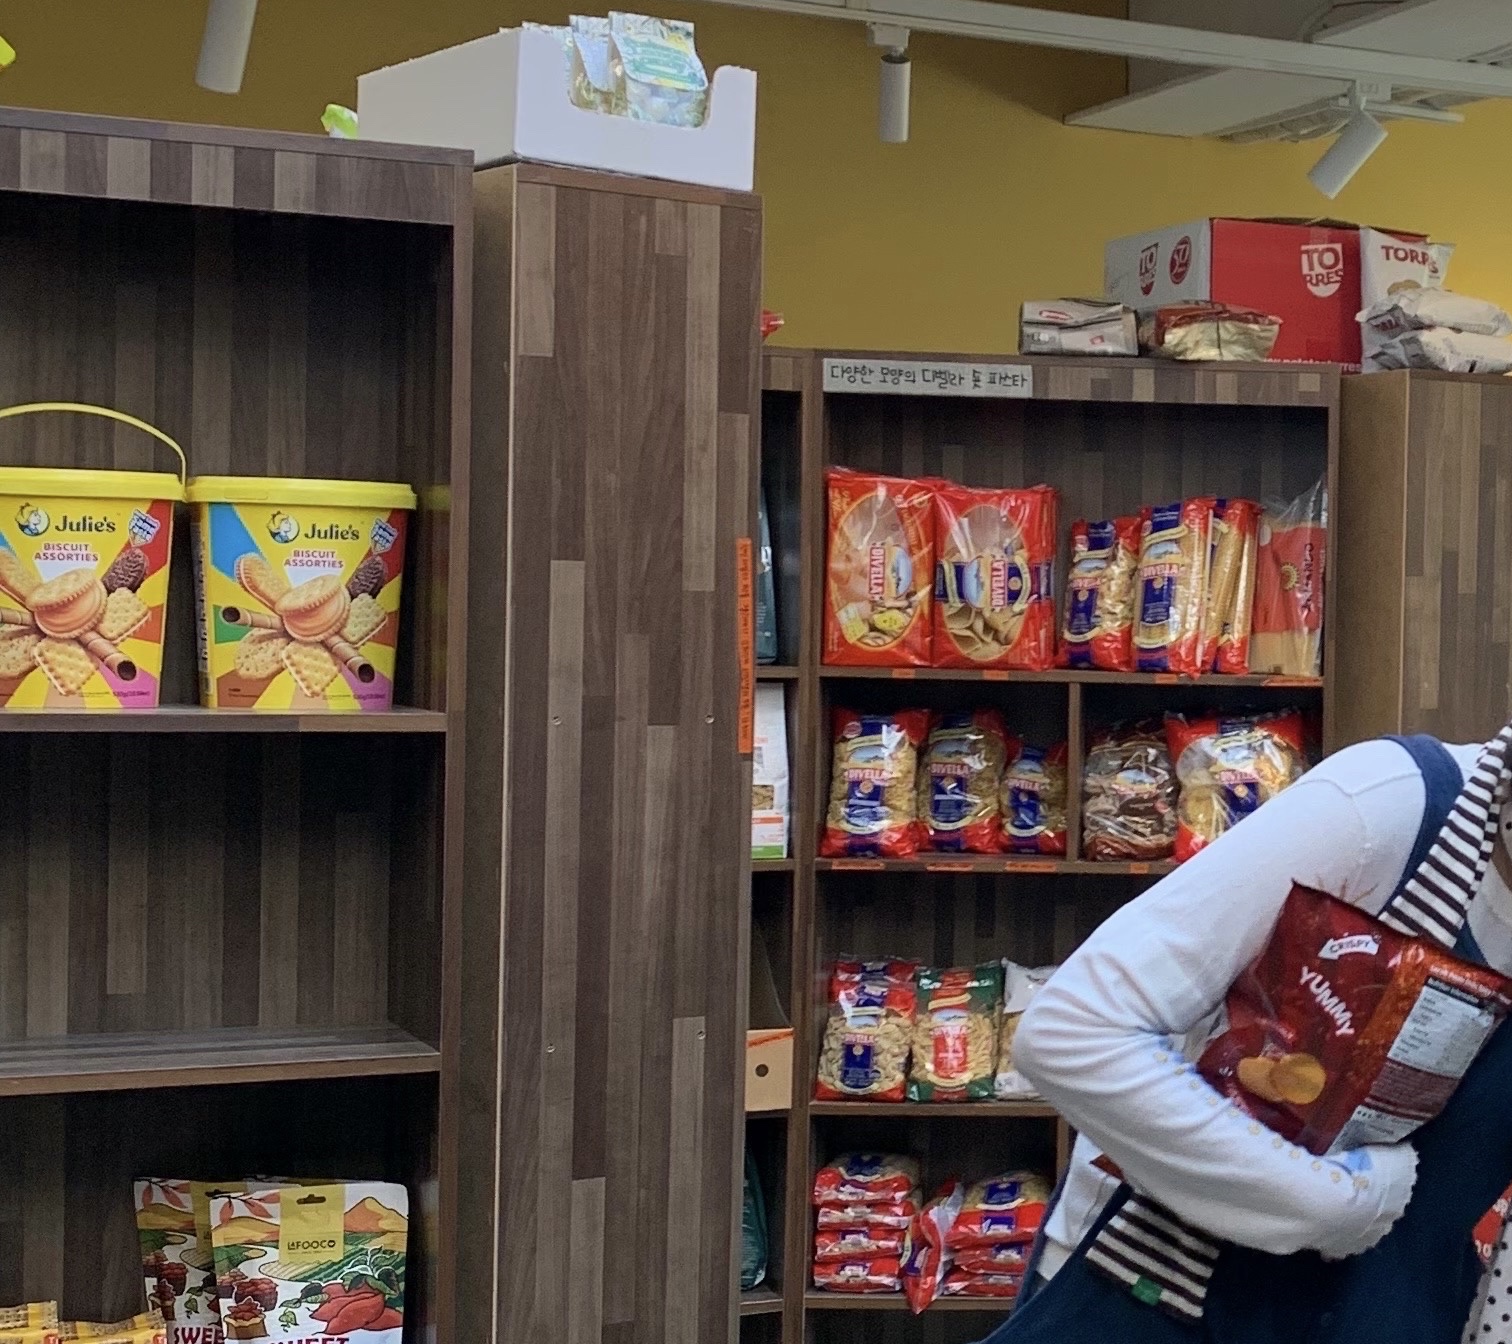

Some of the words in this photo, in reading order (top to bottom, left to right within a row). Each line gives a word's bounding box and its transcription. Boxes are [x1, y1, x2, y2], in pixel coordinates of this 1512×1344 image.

[1301, 244, 1342, 272] TO
[830, 364, 875, 385] 다양한
[879, 366, 917, 386] 모양의
[54, 513, 117, 534] Julie's
[303, 523, 361, 542] Julie's
[43, 542, 90, 553] BISCUIT
[292, 549, 337, 560] BISCUIT
[34, 551, 100, 563] ASSORTIES
[283, 558, 345, 570] ASSORTIES
[1329, 938, 1371, 956] CRISPY
[1300, 966, 1356, 1038] YUMMY
